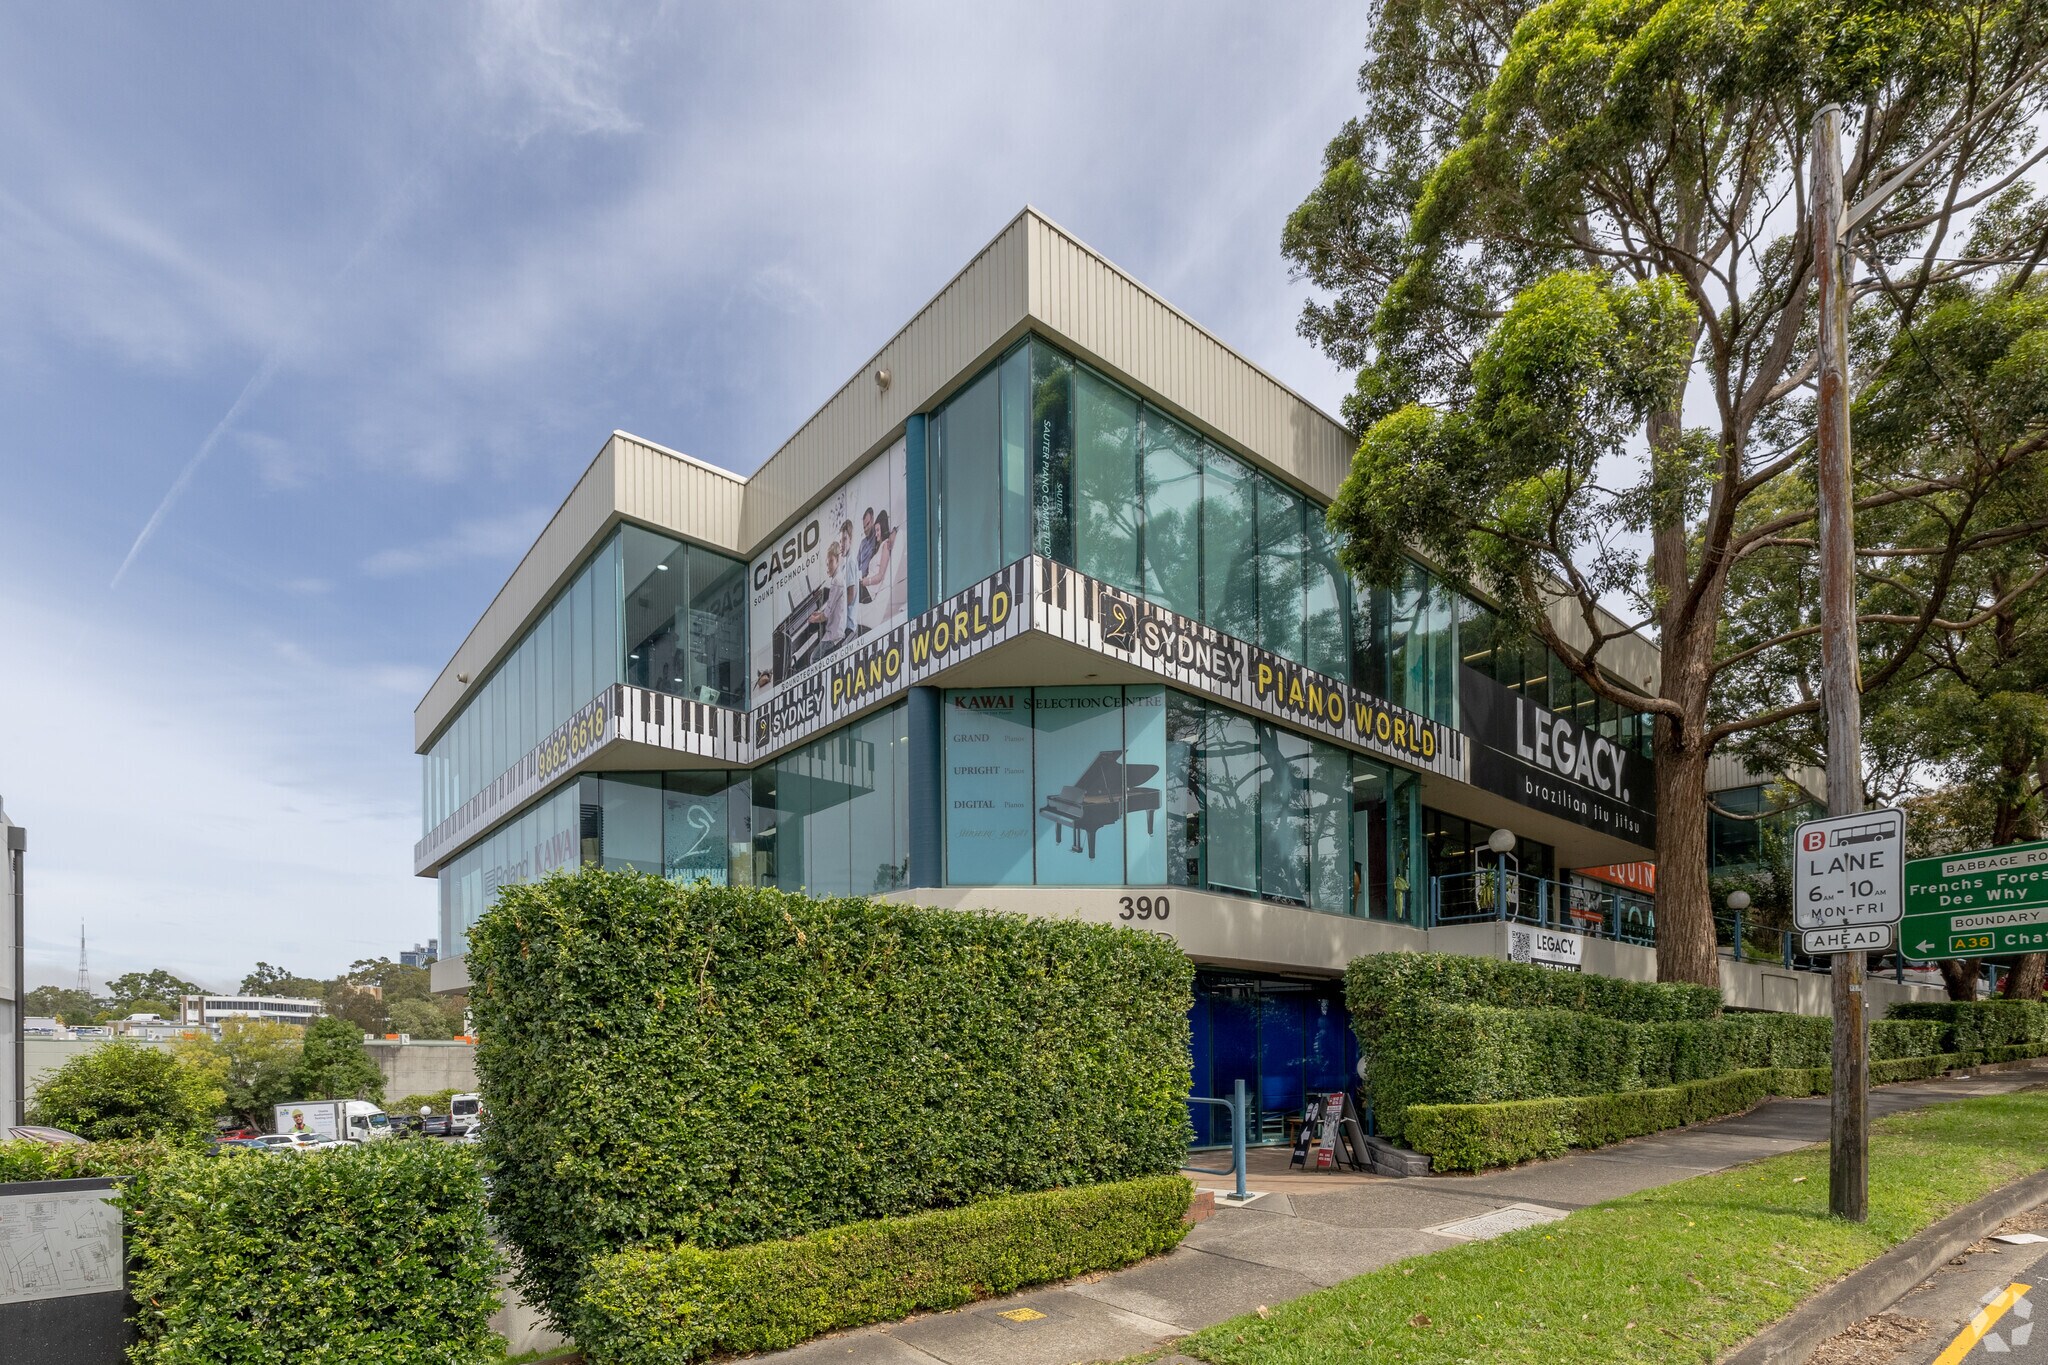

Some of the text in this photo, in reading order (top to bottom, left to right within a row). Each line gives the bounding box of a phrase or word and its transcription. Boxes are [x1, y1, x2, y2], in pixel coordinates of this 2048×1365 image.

[1042, 419, 1051, 458] SAUTER
[1041, 462, 1050, 493] PIANO
[754, 519, 820, 591] CASIO
[754, 586, 774, 607] SOUND
[776, 551, 820, 590] TECHNOLOGY
[773, 590, 1009, 735] SYDNEY PIANO WORLD
[1143, 621, 1435, 758] SYDNEY PIANO WORLD
[955, 695, 1162, 710] KAWAI SELECTION CENTRE
[538, 706, 604, 779] 9882 6618
[953, 733, 1025, 743] GRAND Pianos
[1516, 696, 1630, 803] LEGACY.
[953, 766, 1025, 775] UPRIGHT Pianos
[953, 800, 1025, 809] DIGITAL Pianos
[1525, 775, 1640, 834] brazilian jiu jitsu
[534, 823, 579, 875] KAWAI
[1808, 832, 1822, 851] B
[496, 850, 529, 886] Roland
[1810, 851, 1884, 876] LANE
[1946, 856, 2018, 874] BABBAGE
[1909, 879, 1984, 896] Frenchs
[1939, 888, 2028, 906] Dee Why
[1119, 896, 1170, 920] 390
[1811, 902, 1884, 919] MON-FRI
[1955, 911, 2040, 928] BOUNDARY
[1536, 934, 1576, 956] LEGACY.
[1814, 931, 1880, 947] AHEAD
[1954, 937, 1990, 949] A38
